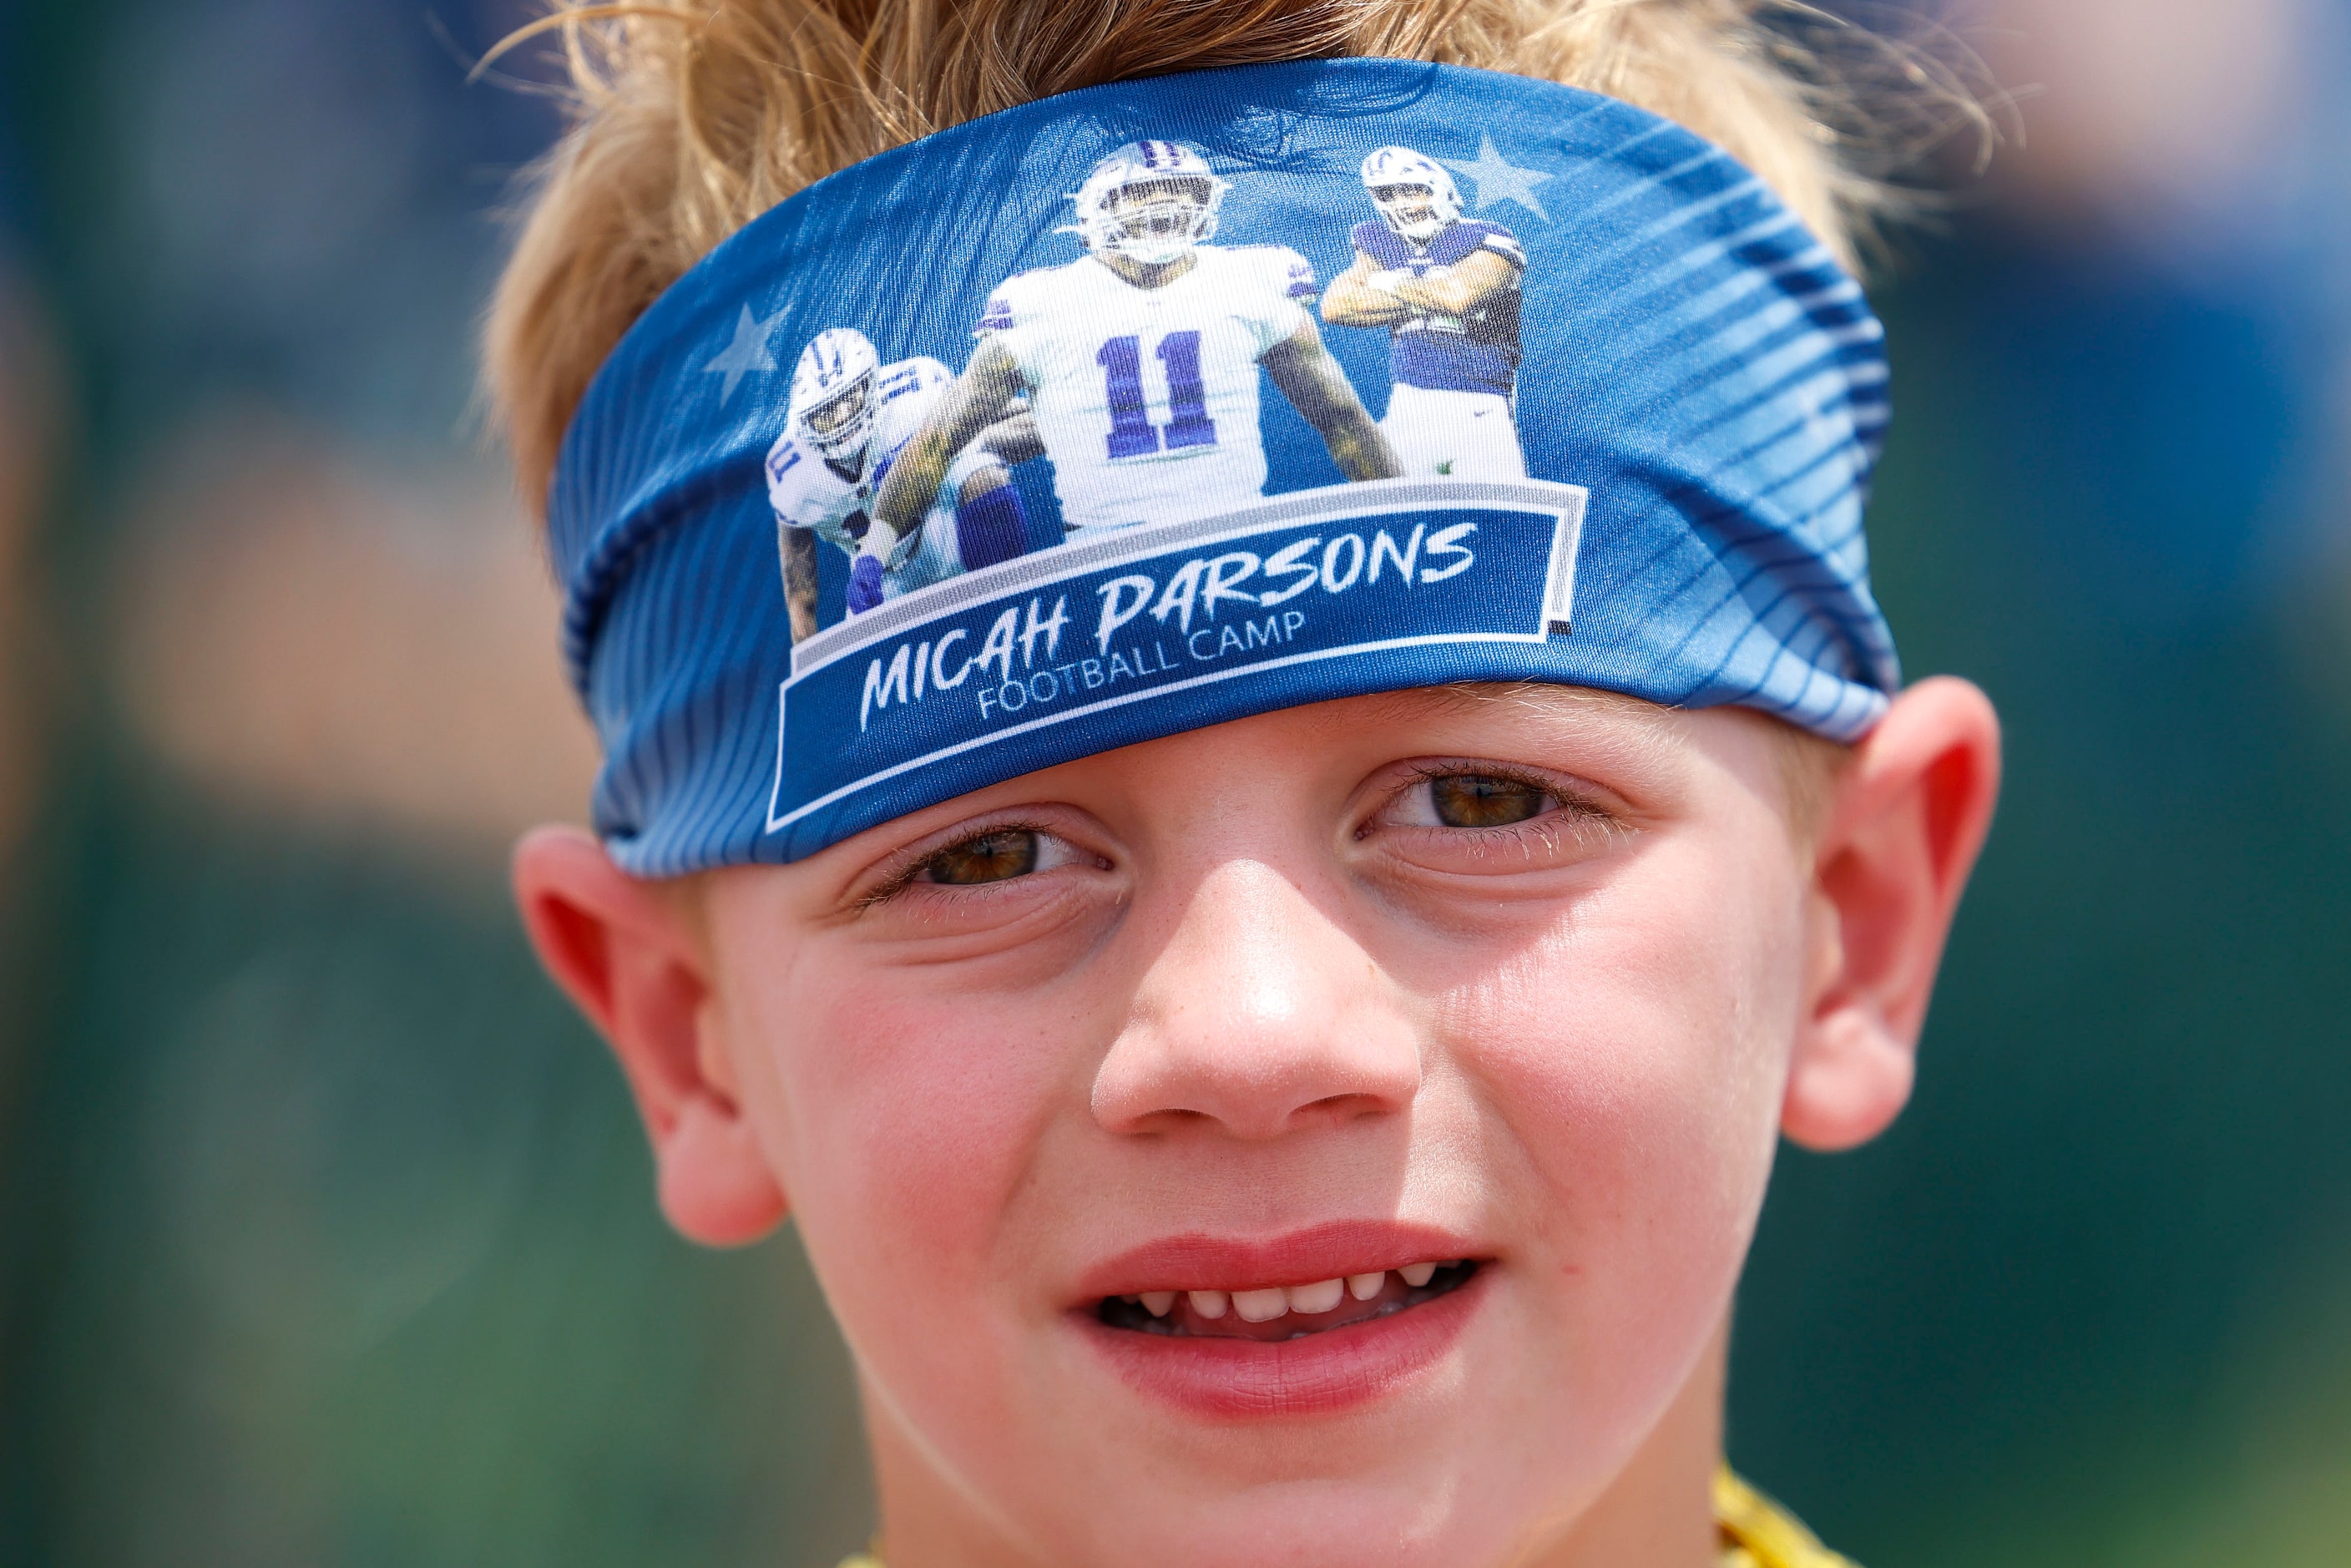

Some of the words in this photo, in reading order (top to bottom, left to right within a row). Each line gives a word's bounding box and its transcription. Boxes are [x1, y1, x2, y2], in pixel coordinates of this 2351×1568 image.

[1096, 331, 1217, 459] 11
[861, 597, 1071, 732] MICAH
[1095, 522, 1477, 653] PARSONS
[979, 644, 1178, 721] FOOTBALL
[1189, 610, 1305, 661] CAMP
